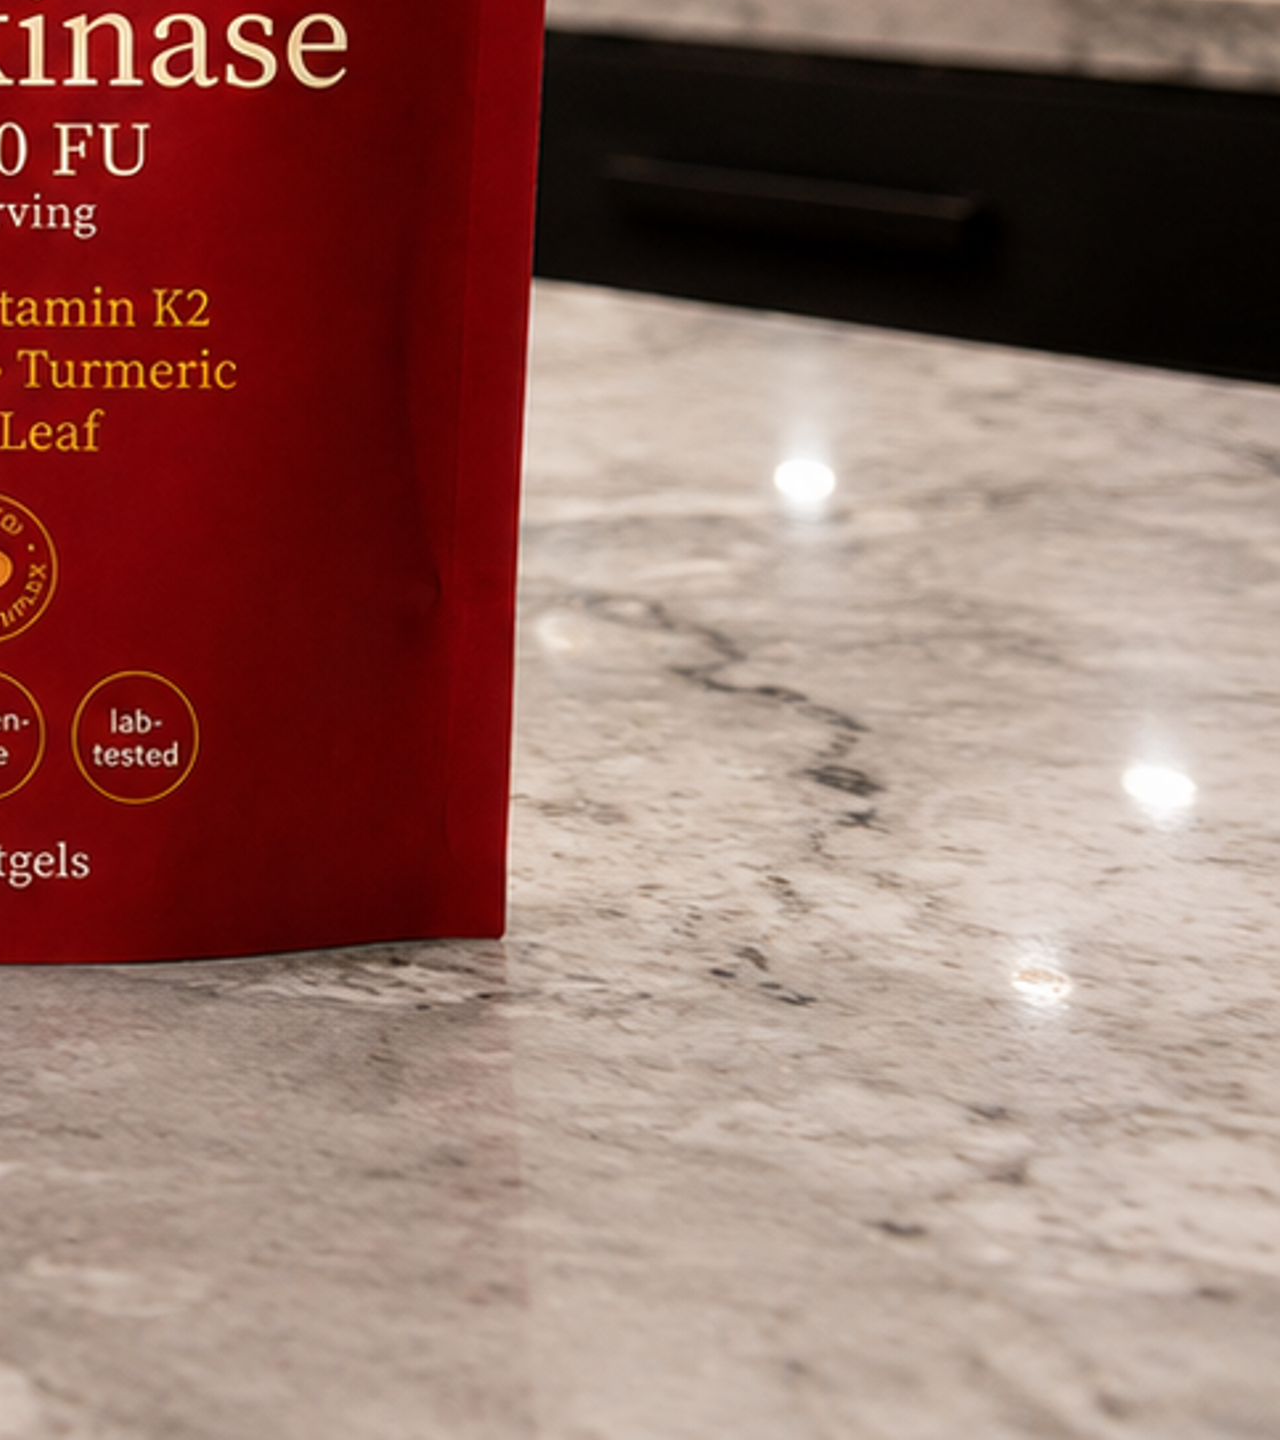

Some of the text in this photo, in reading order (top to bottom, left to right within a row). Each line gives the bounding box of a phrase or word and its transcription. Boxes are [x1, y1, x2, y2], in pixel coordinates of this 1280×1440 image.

[53, 122, 150, 177] FU
[153, 288, 210, 327] K2
[17, 349, 237, 389] Turmeric
[110, 708, 162, 734] lab-
[93, 741, 179, 767] tested
